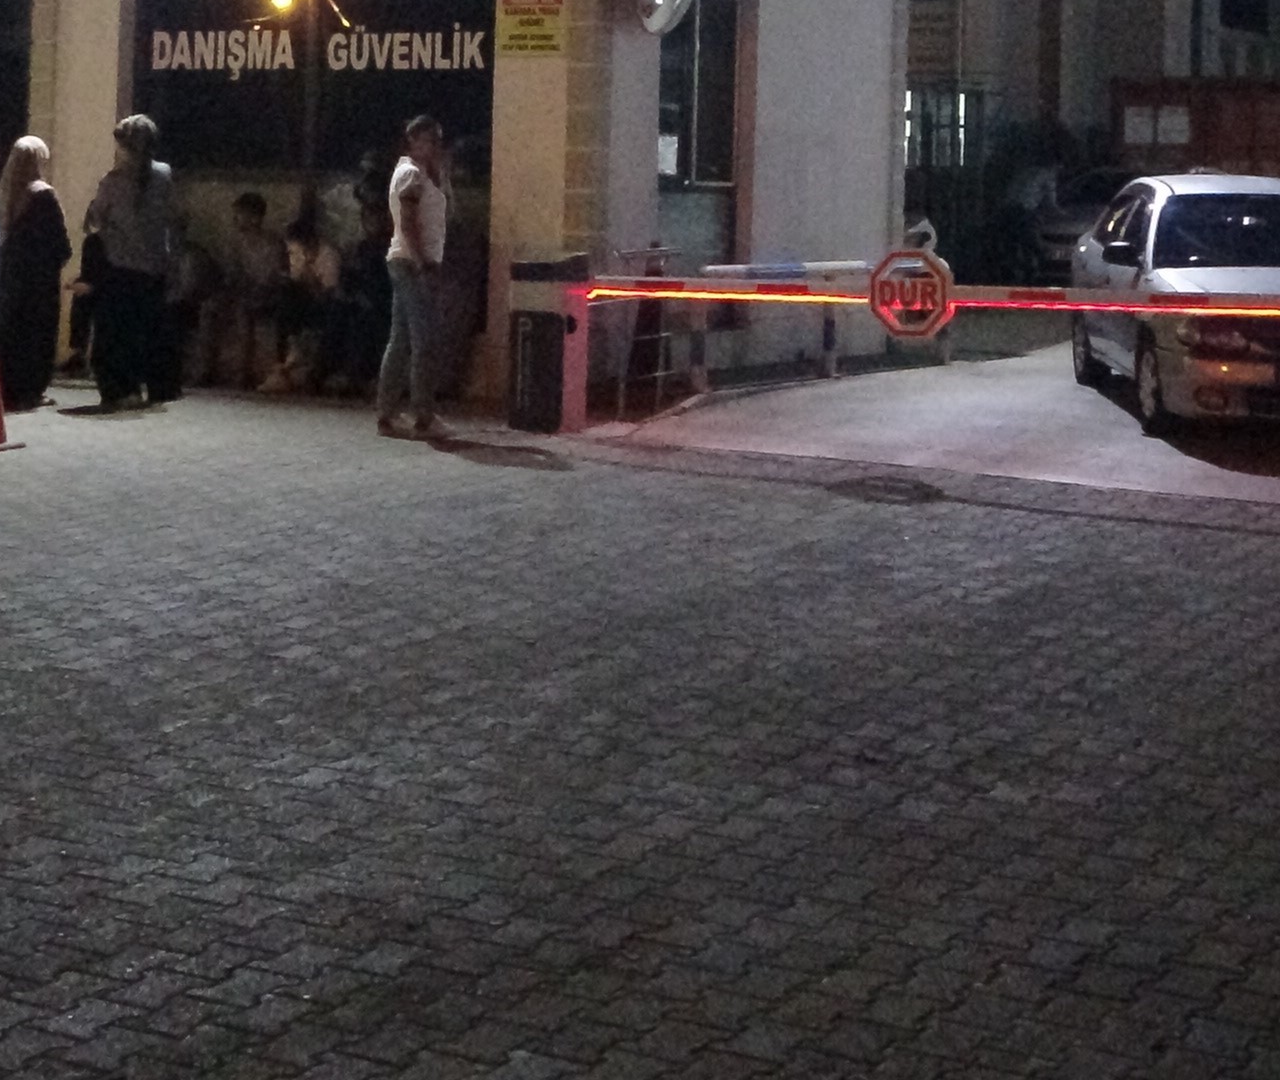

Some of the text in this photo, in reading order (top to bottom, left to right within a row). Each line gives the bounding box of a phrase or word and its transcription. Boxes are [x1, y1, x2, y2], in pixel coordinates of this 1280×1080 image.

[152, 23, 485, 80] DANIŞMA GÜVENLİK
[878, 279, 938, 308] DUR
